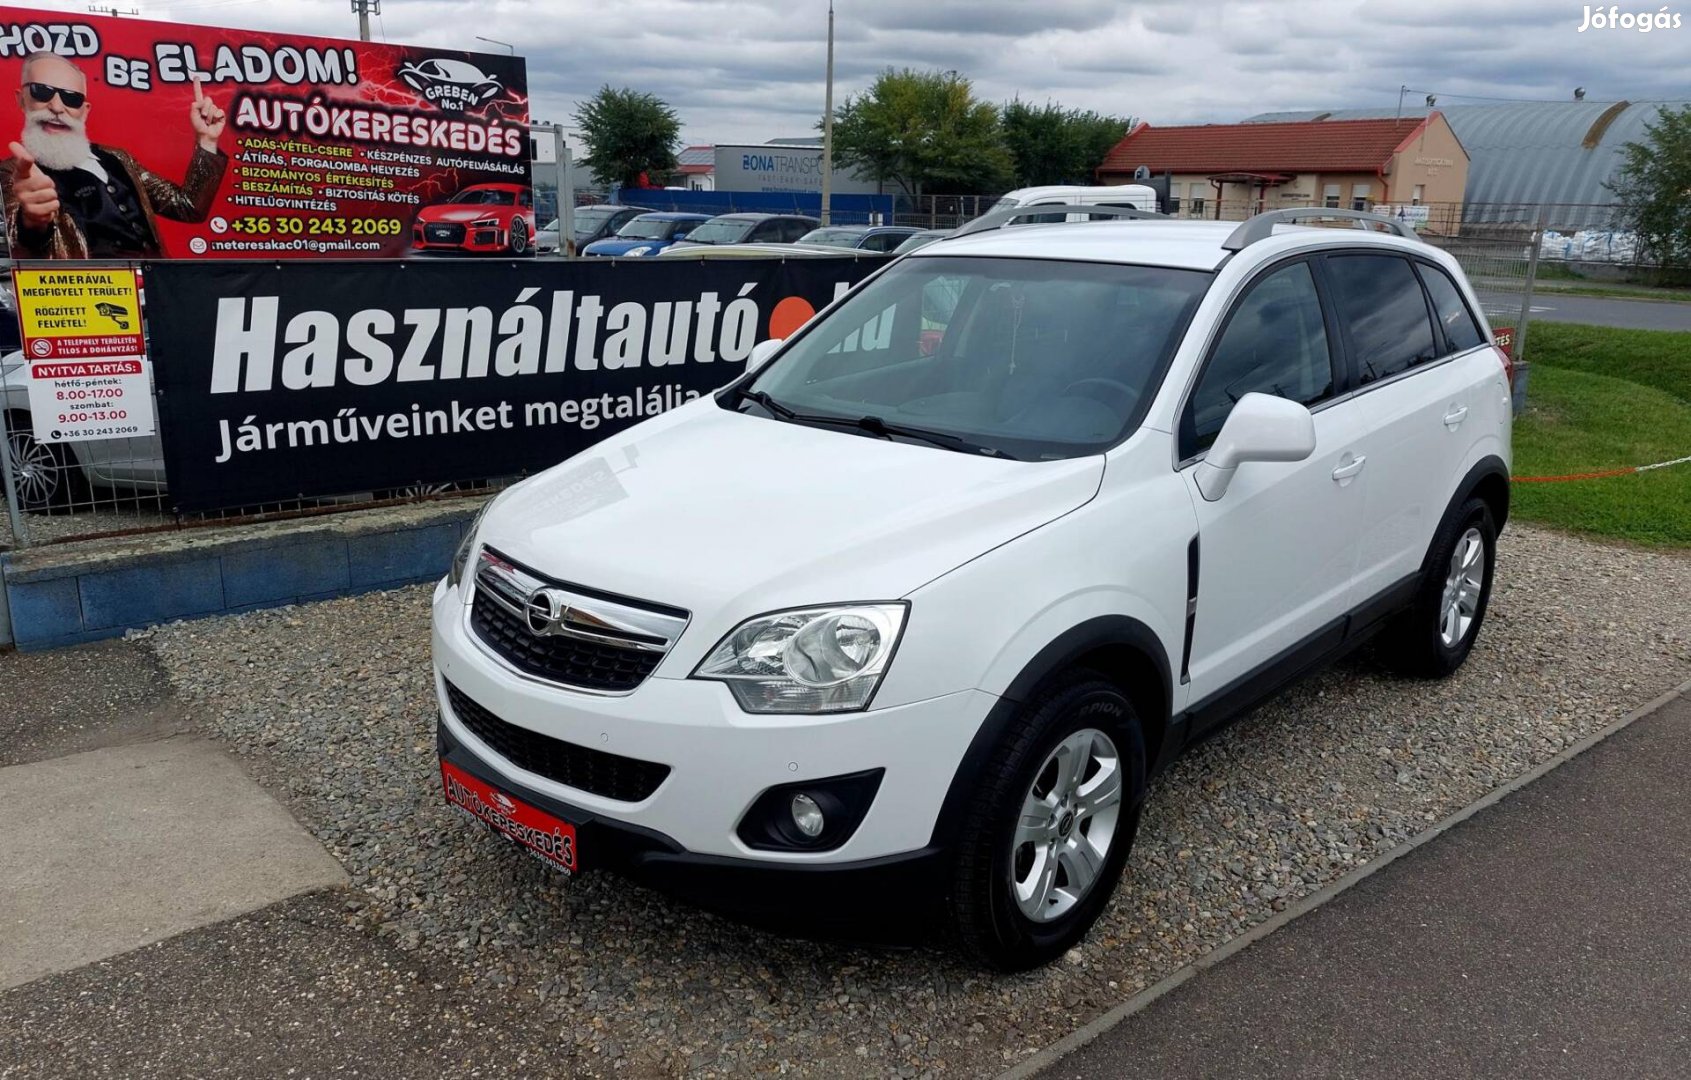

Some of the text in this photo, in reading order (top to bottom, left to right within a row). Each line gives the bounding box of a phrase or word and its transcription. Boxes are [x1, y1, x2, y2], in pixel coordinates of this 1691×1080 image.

[0, 24, 357, 90] HOZD BE ELADOM!
[425, 86, 479, 106] GREBEN
[441, 100, 464, 111] No.1
[236, 97, 522, 156] AUTÓKERESKEDÉS
[242, 150, 420, 178] ÁTÍRÁS, FORGALOMBA HELYEZÉS
[244, 137, 525, 175] ADÁS-VÉTEL-CSERE KÉSZPÉNZES AUTÓFELVÁSÁRLÁS
[241, 166, 394, 189] BIZOMÁNYOS ÉRTÉKESÍTÉS
[242, 181, 420, 204] BESZÁMÍTÁS BIZTOSÍTÁS KÖTÉS
[235, 194, 337, 212] HITELÜGYINTÉZÉS
[232, 217, 402, 235] +36 30 243 2069
[39, 273, 114, 285] KAMERÁVAL
[22, 285, 133, 297] MEGFIGYELT TERÜLET!
[35, 305, 87, 317] RÖGZÍTETT
[38, 317, 87, 329] FELVÉTEL!
[210, 282, 759, 394] Használtautó
[38, 362, 136, 377] NYITVA TARTÁS:
[56, 388, 123, 400] 8.00-17.00
[70, 401, 114, 410] szombat:
[58, 410, 127, 423] 9.00-13.00
[115, 426, 138, 434] 2069
[215, 399, 514, 464] Járműveinket
[447, 772, 574, 867] AUTÓKERESKEDÉS
